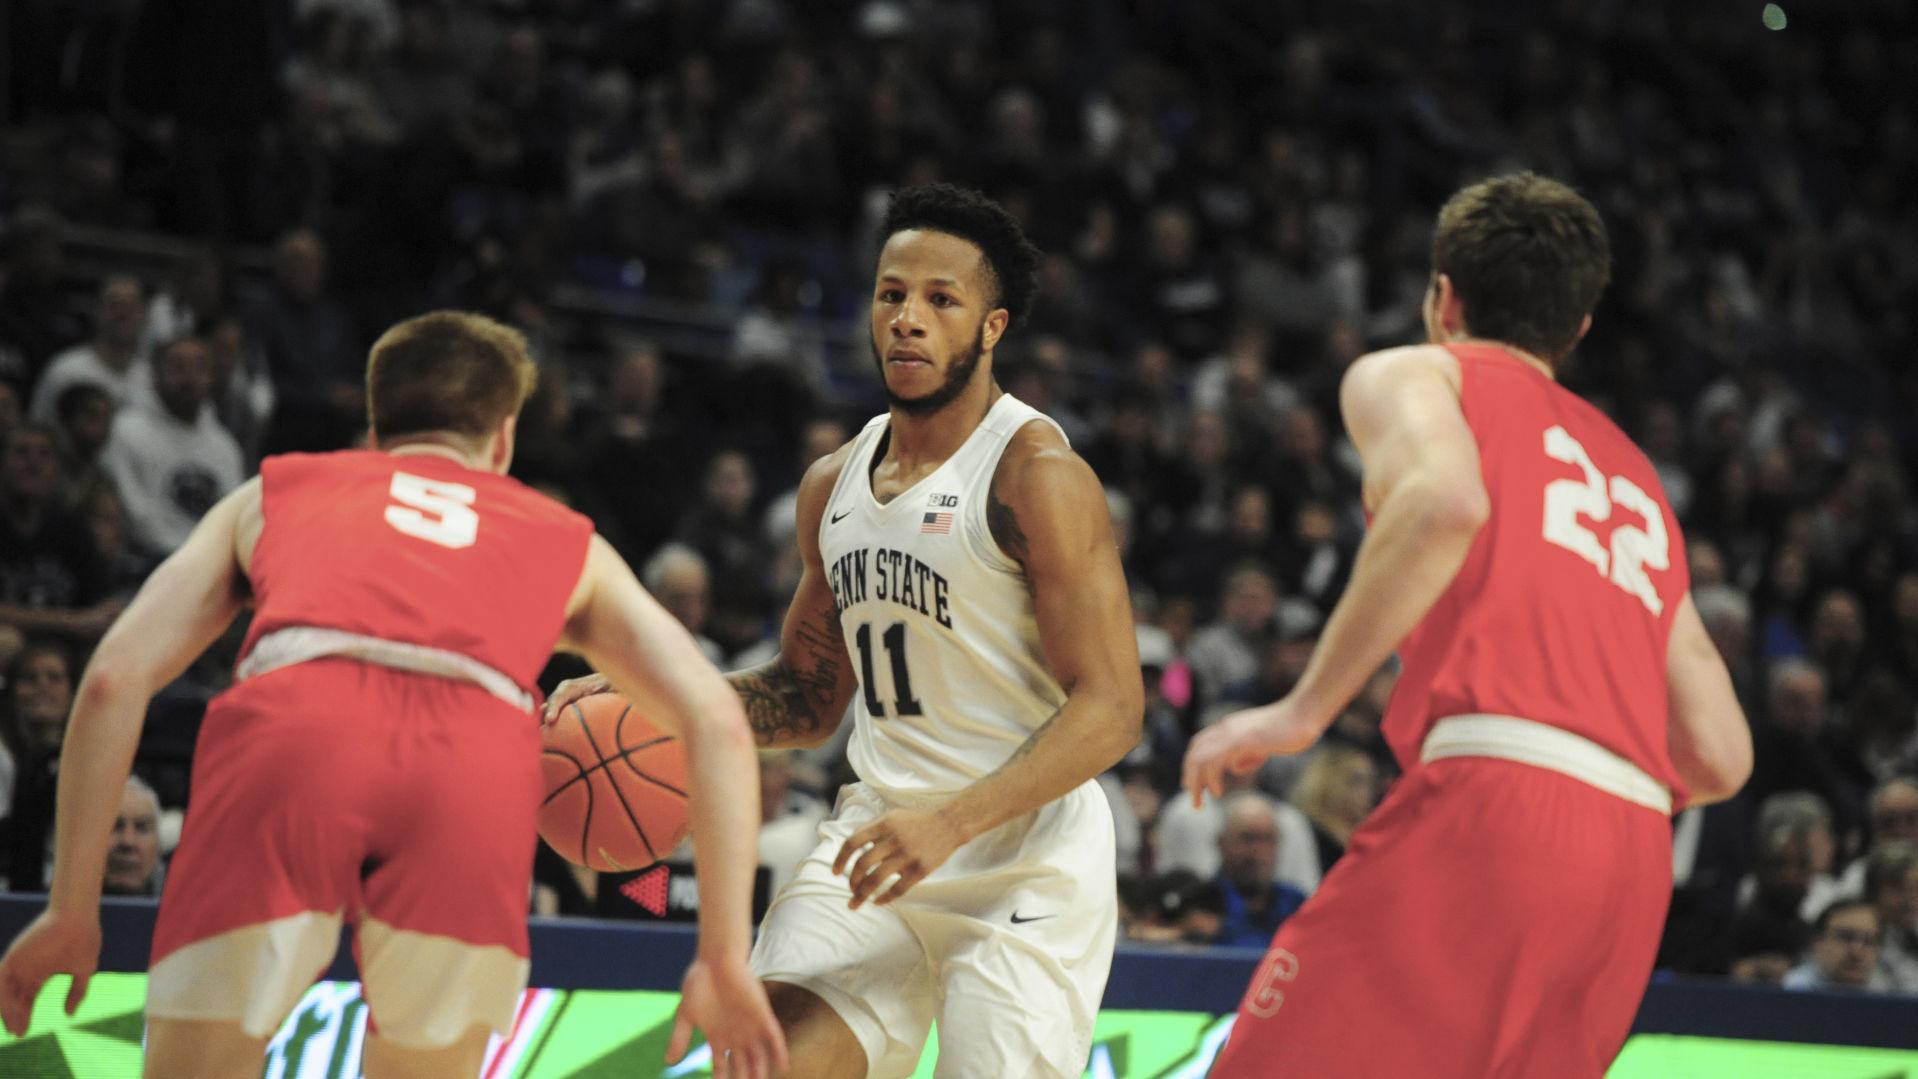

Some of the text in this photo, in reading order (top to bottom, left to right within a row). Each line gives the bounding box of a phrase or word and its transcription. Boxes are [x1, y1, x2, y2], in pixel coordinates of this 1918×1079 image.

[384, 470, 479, 549] 5
[1542, 425, 1670, 618] 22
[830, 548, 953, 630] ENN STATE
[856, 622, 924, 717] 11
